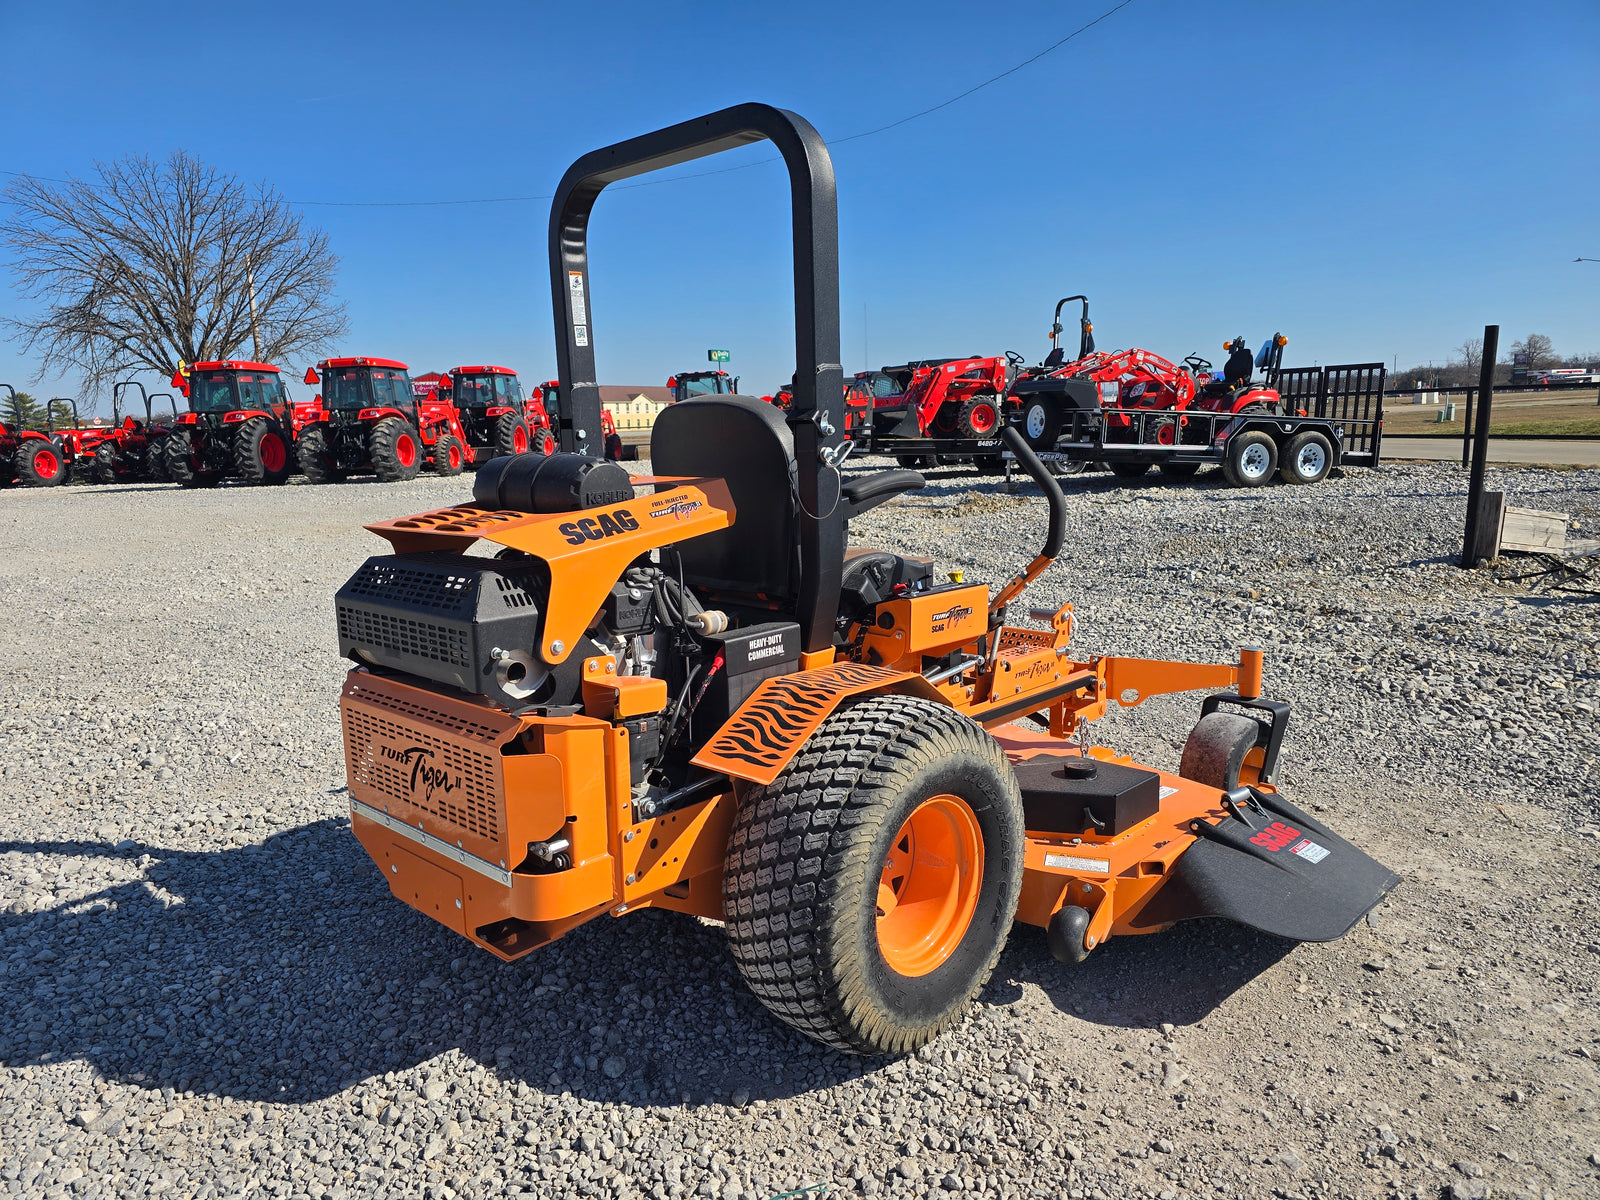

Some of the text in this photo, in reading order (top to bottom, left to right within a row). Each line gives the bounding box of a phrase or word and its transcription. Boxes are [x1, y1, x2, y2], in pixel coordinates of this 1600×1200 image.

[586, 489, 629, 506] KOHLER
[651, 494, 688, 507] FUEL-INJECTED
[650, 507, 675, 518] TURF
[558, 509, 640, 545] SCAG
[749, 633, 782, 650] HEAVY-DUTY
[748, 644, 785, 661] COMMERCIAL
[380, 745, 462, 802] TURF Tiger II
[1249, 822, 1301, 852] SCAG
